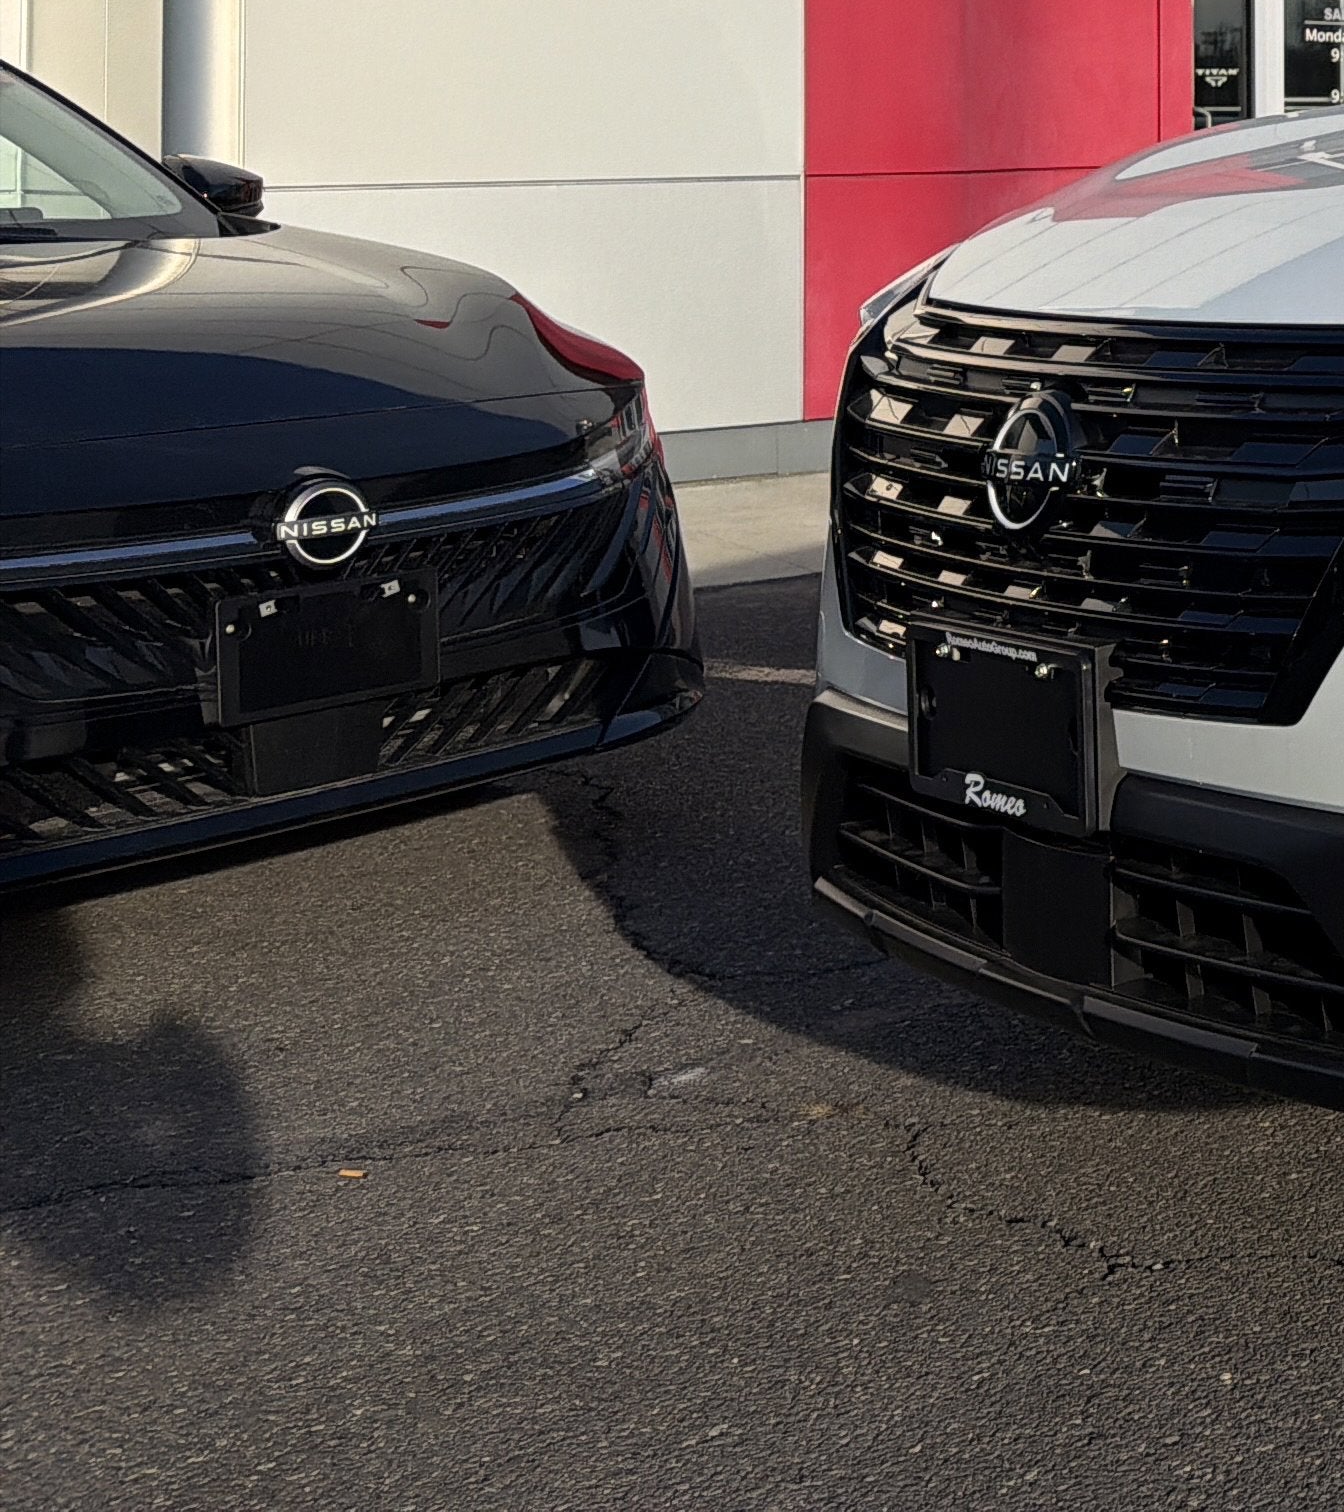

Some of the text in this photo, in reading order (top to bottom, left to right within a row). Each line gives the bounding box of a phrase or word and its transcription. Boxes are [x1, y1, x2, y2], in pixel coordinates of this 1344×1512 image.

[982, 453, 1070, 483] NISSAN
[280, 512, 377, 539] NISSAN
[945, 631, 1038, 663] RomeoAutoGroup.com
[964, 773, 1027, 817] Romeo
